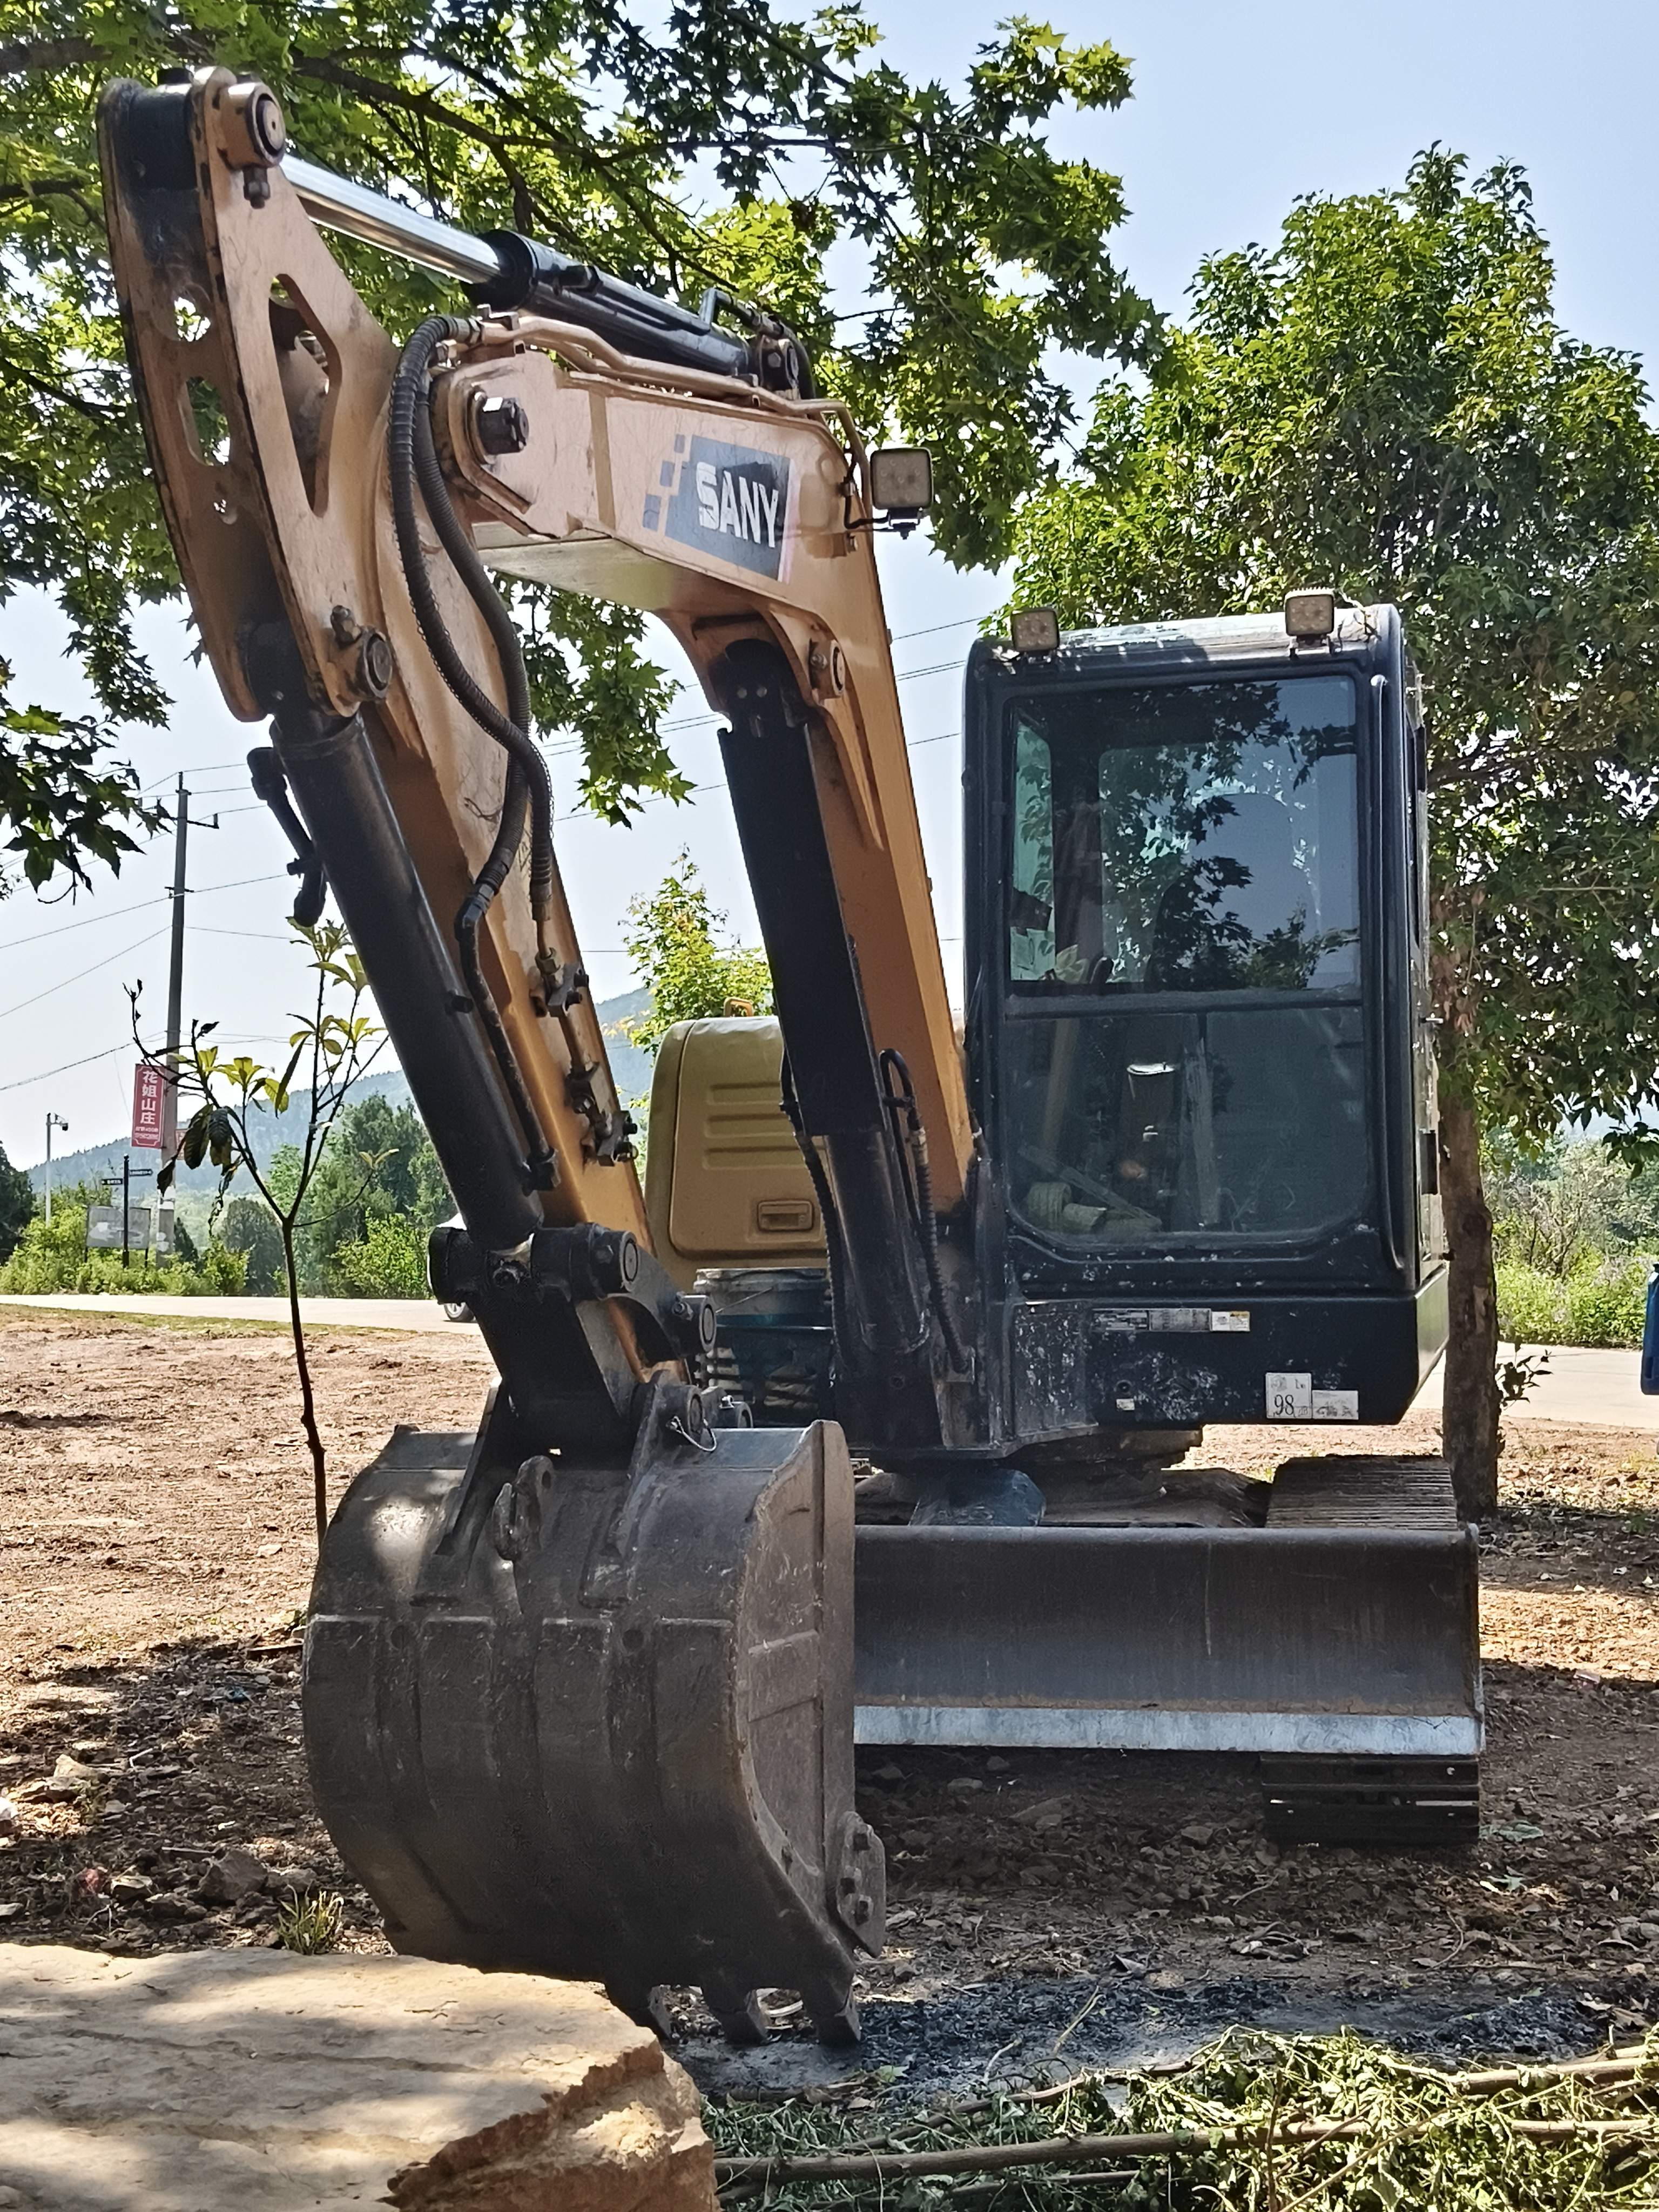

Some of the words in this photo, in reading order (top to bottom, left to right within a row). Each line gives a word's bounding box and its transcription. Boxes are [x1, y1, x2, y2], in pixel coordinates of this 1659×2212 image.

[696, 461, 779, 548] SANY
[140, 1070, 158, 1125] 花姐山庄
[1274, 1394, 1294, 1415] 98
